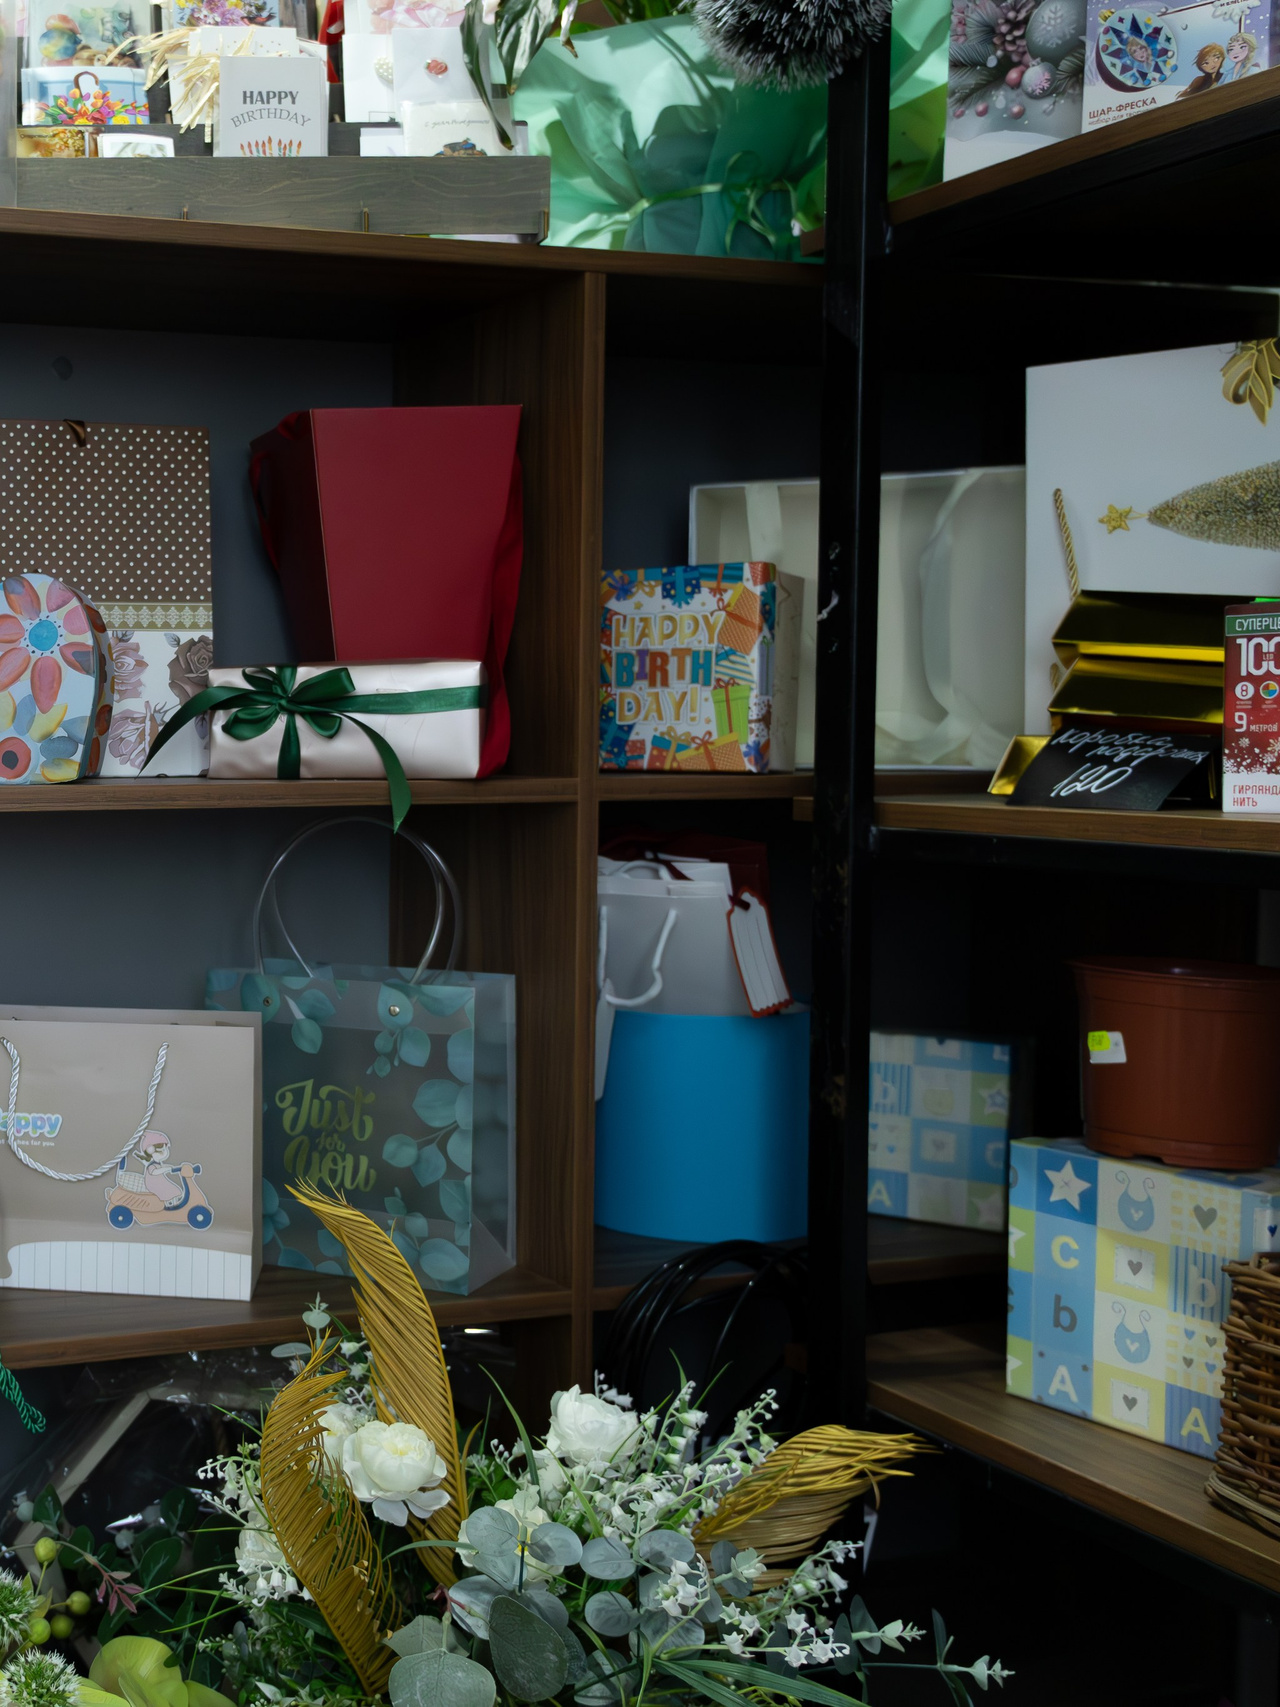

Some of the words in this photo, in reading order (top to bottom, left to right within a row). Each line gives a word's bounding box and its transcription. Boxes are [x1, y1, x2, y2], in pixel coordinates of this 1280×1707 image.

[242, 90, 299, 105] HAPPY
[1089, 96, 1157, 119] ШАР-ФРЕСКА
[230, 107, 312, 128] BIRTHDAY
[613, 612, 725, 648] HAPPY
[1235, 616, 1280, 632] СУПЕРЦ
[615, 647, 713, 689] BIRTH
[617, 686, 699, 723] DAY!
[1234, 711, 1248, 732] 9
[1050, 763, 1133, 798] 120
[1233, 784, 1280, 796] ГИРЛЯНД
[1232, 797, 1258, 807] НИТЬ
[275, 1078, 376, 1142] Just
